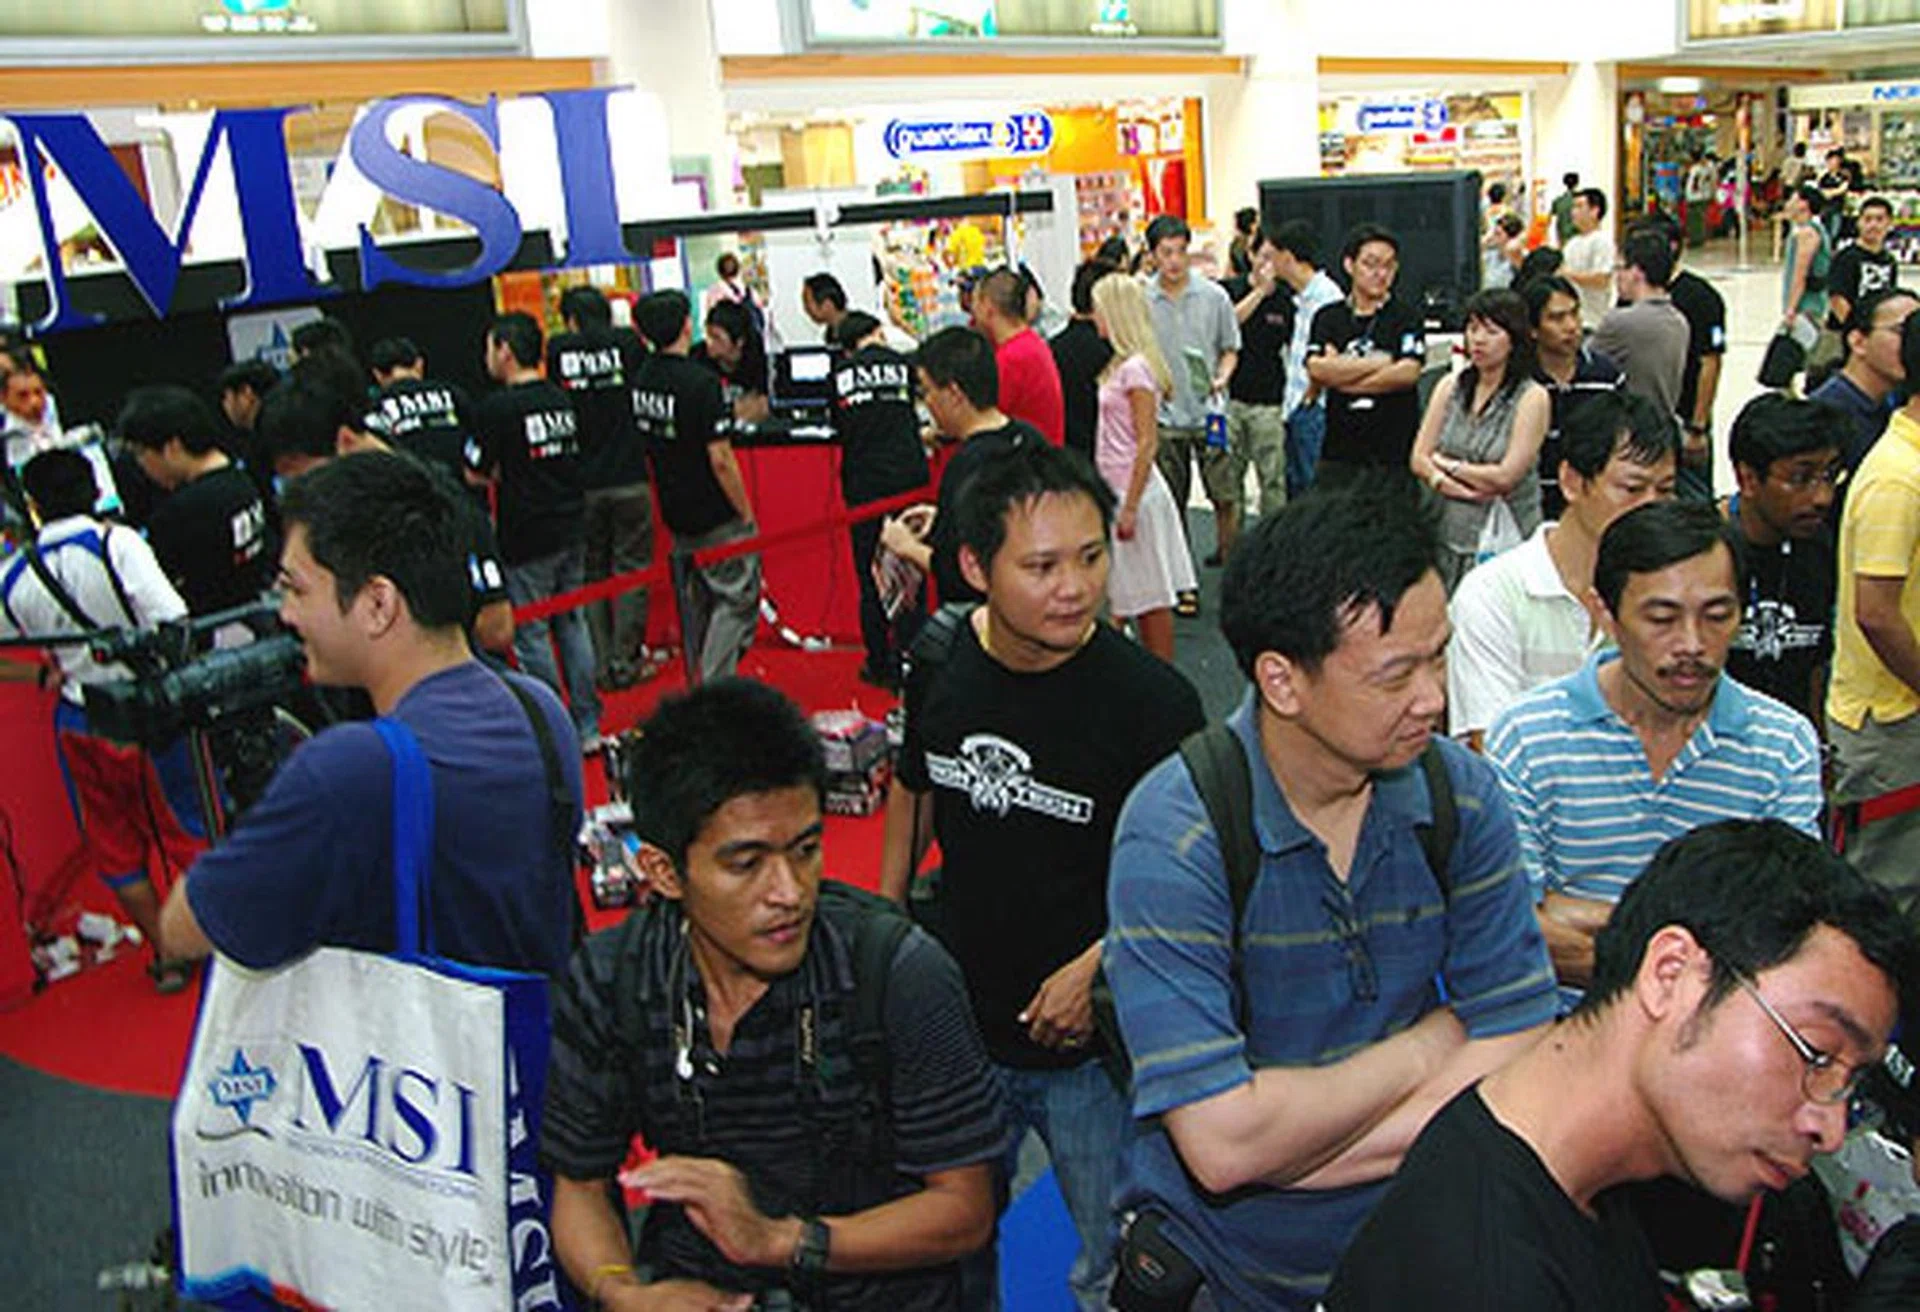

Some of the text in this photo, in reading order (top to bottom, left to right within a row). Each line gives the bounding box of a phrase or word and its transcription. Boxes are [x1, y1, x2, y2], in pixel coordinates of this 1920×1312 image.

[0, 84, 652, 338] MSI
[295, 1042, 479, 1176] MSI
[351, 1197, 401, 1248] with
[410, 1219, 491, 1272] style
